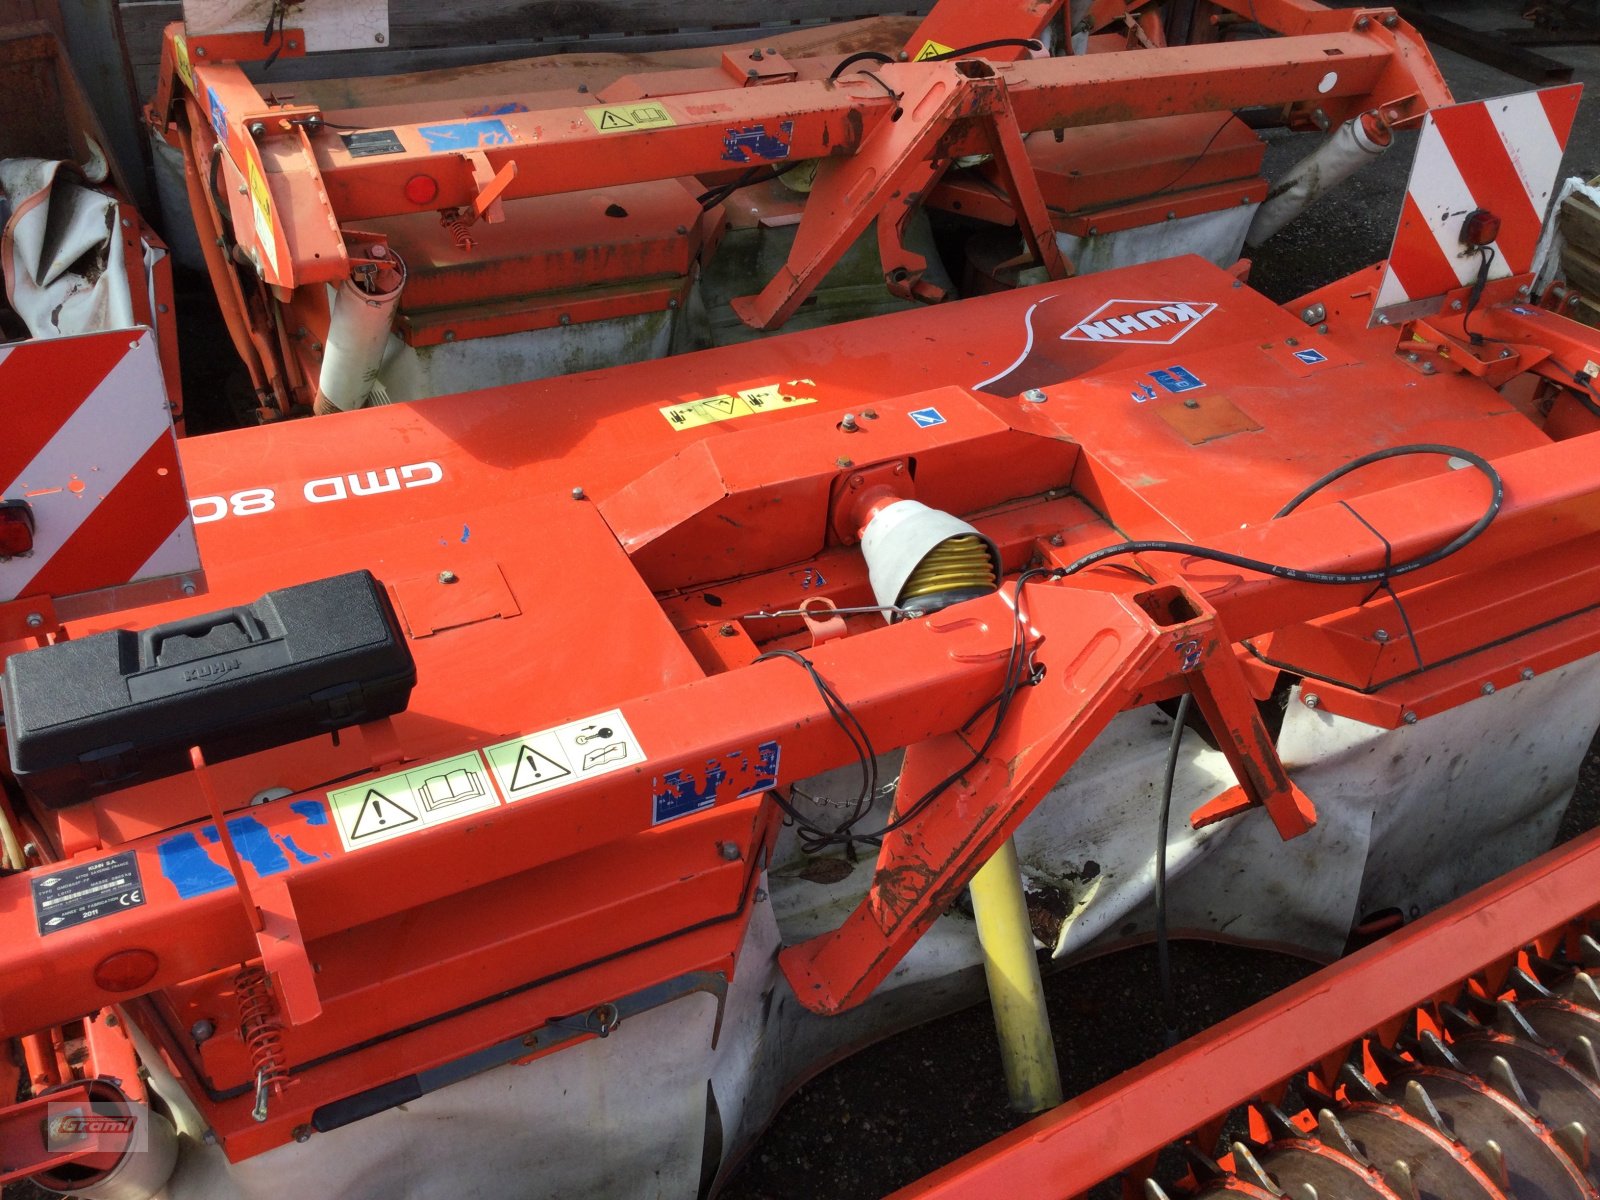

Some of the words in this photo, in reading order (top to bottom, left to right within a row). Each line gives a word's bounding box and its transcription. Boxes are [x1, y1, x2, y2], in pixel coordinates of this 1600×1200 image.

[1077, 303, 1201, 341] KUHN
[303, 461, 443, 503] GMD
[183, 660, 241, 681] KUHN
[88, 863, 104, 871] KUHN
[82, 909, 99, 919] 2011
